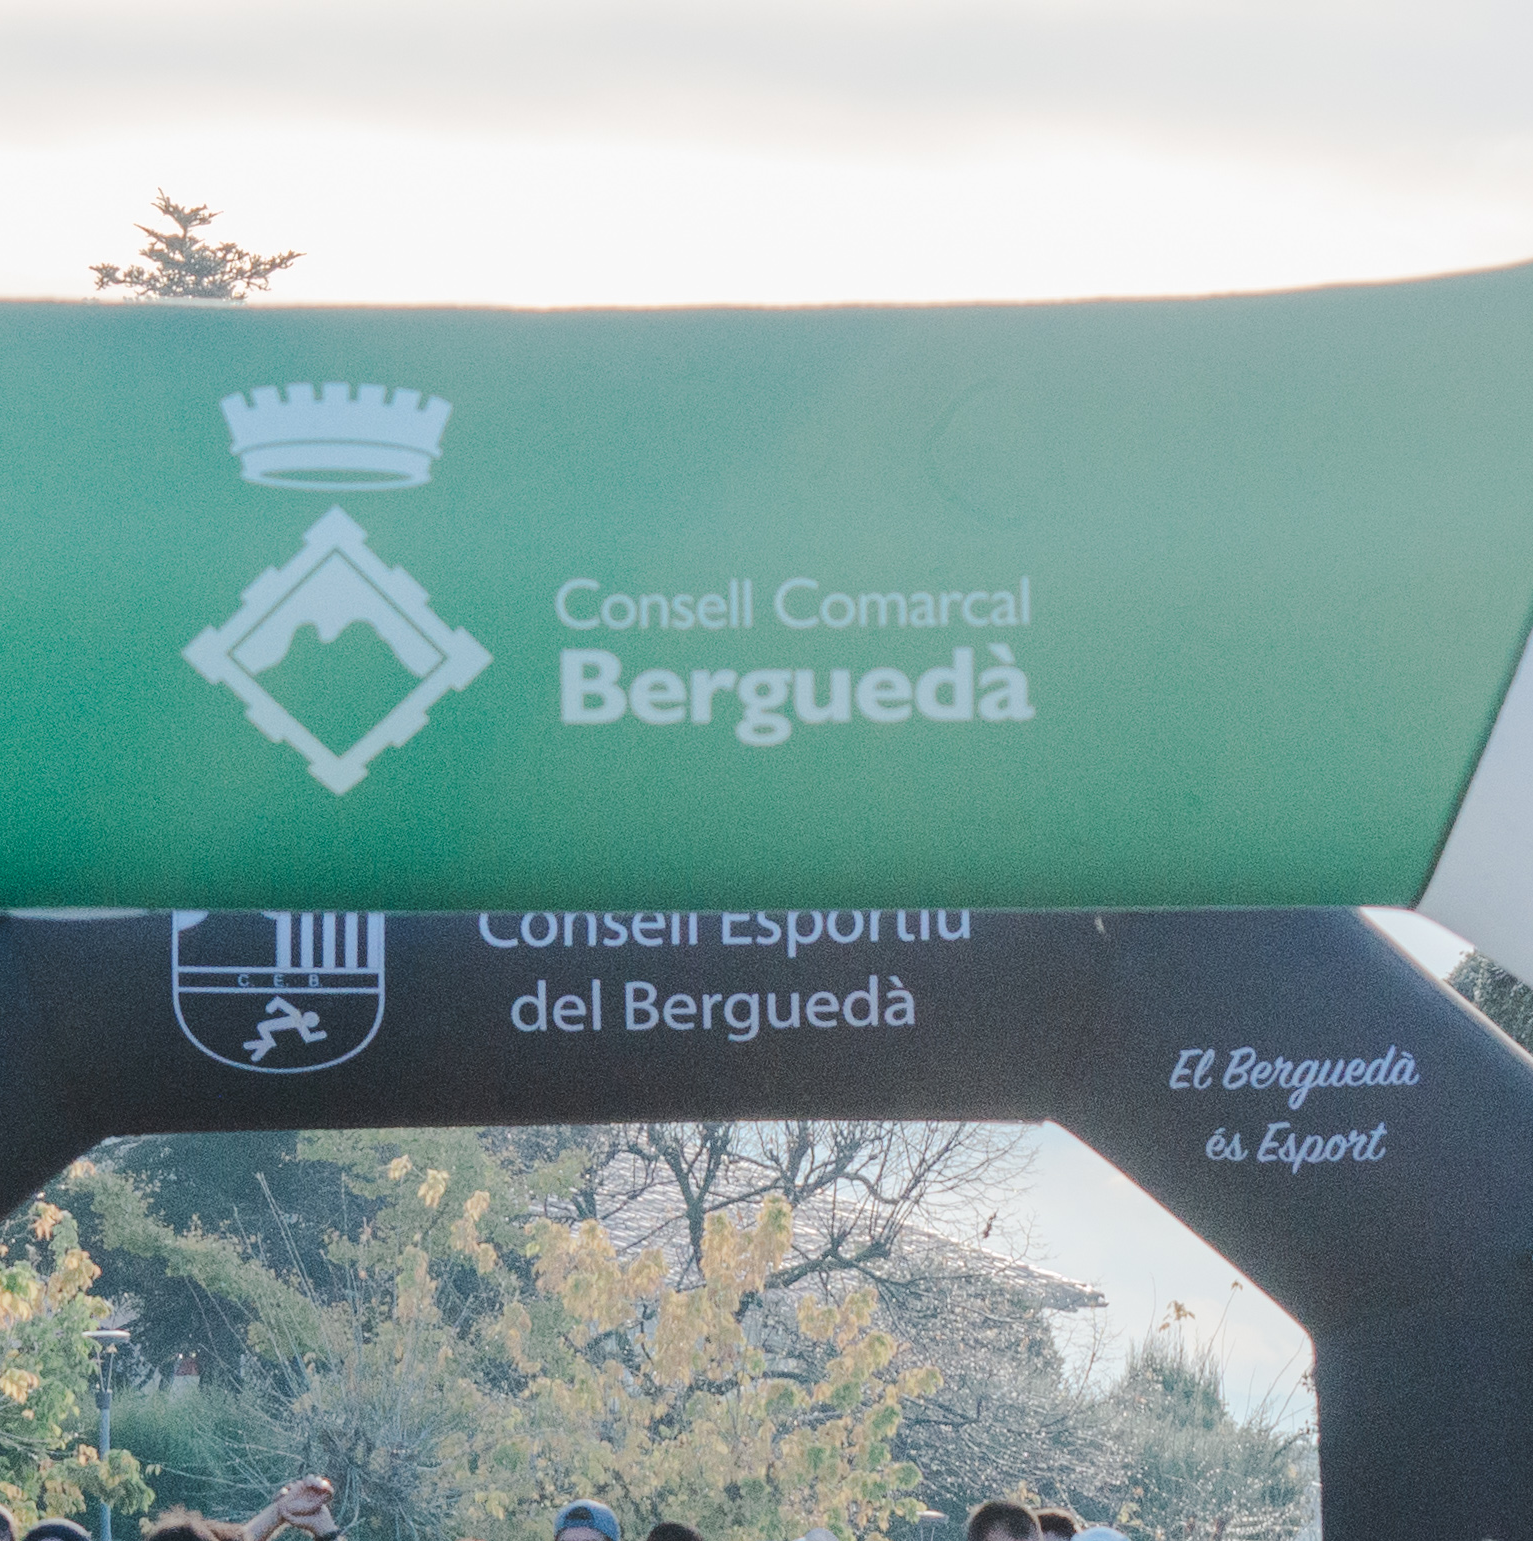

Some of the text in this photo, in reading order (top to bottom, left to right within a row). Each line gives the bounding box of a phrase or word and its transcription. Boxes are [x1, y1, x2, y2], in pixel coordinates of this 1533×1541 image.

[554, 575, 1031, 631] Consell Comarcal
[560, 642, 1037, 747] Berguedà
[479, 910, 972, 958] Consell Esportiu
[510, 974, 916, 1043] del Berguedà
[1168, 1044, 1420, 1110] El Berguedà
[1205, 1120, 1388, 1175] és Esport
